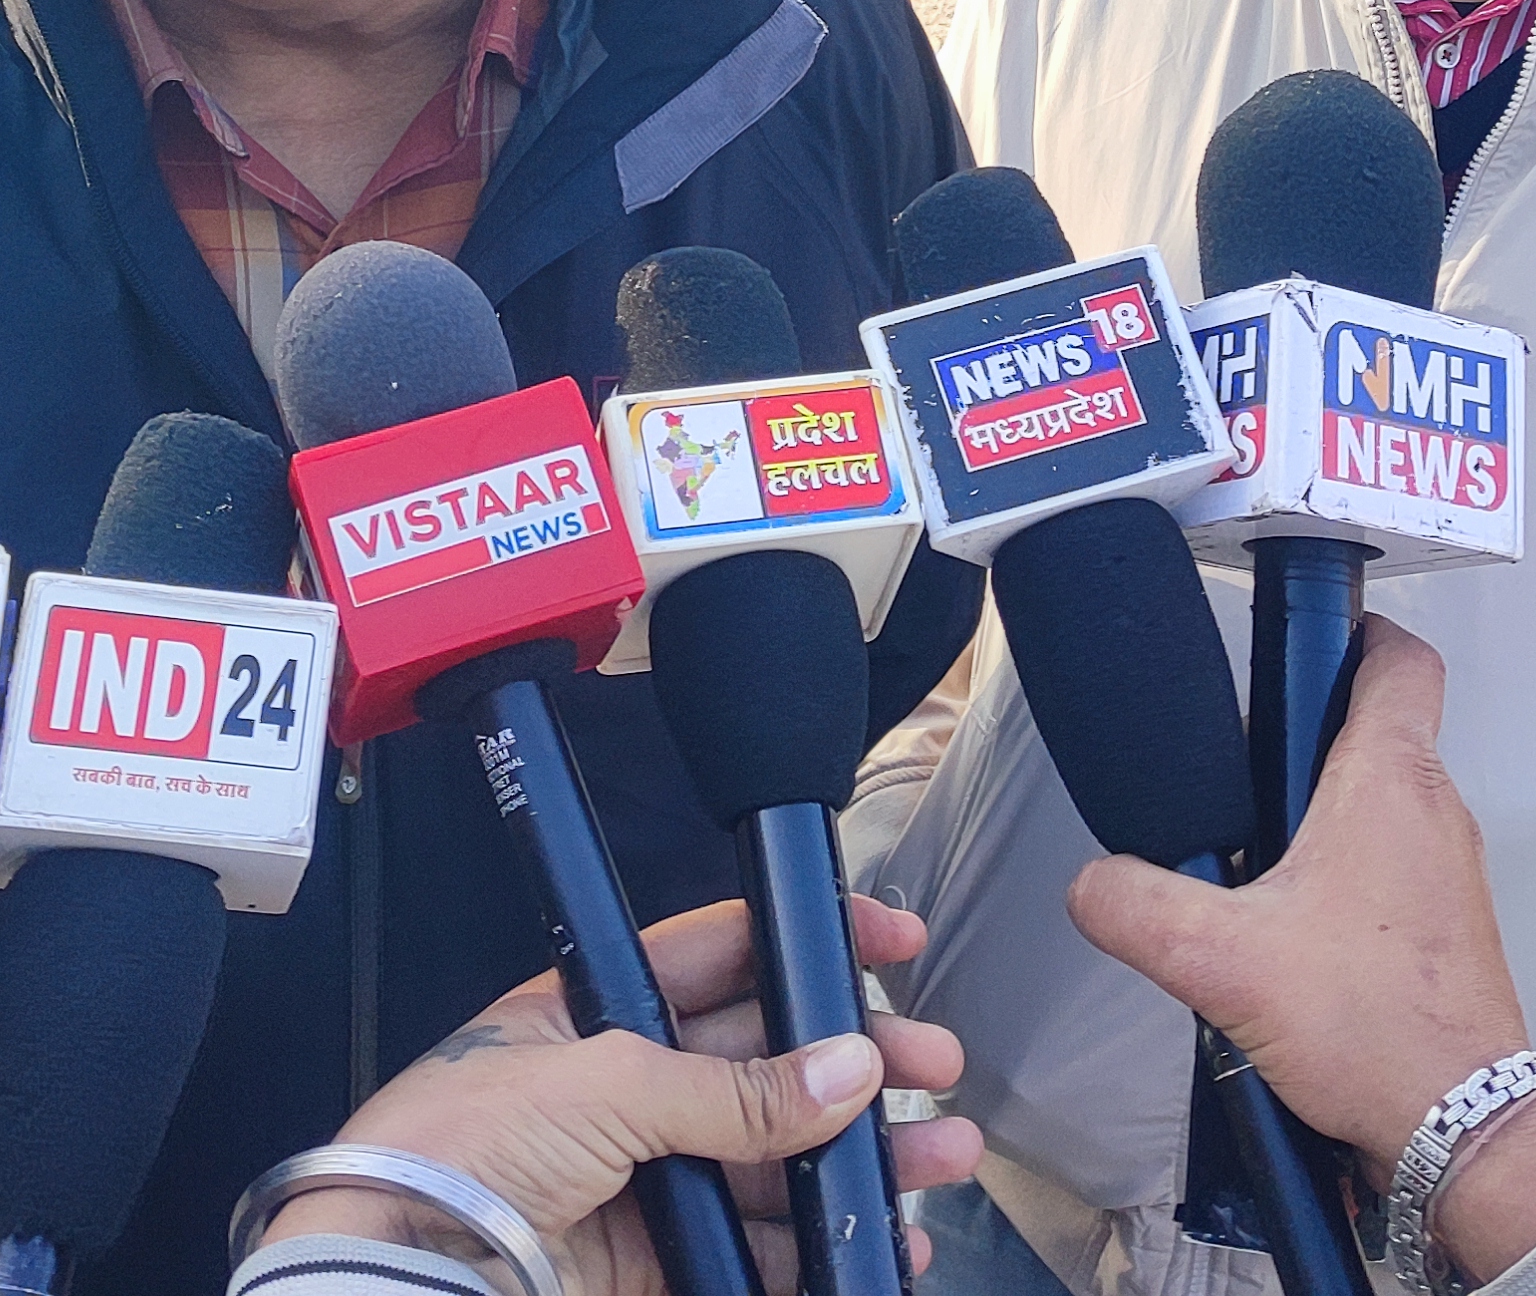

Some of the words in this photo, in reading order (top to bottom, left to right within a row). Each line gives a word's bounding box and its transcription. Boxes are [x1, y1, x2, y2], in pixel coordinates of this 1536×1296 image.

[950, 334, 1092, 405] NEWS
[1085, 302, 1146, 346] 18
[1338, 329, 1491, 433] NMH
[766, 403, 859, 450] प्रदेश
[963, 387, 1128, 454] मध्यप्रदेश
[762, 453, 881, 496] हलचल
[1337, 415, 1497, 507] NEWS
[342, 458, 588, 559] VISTAAR
[491, 511, 583, 559] NEWS
